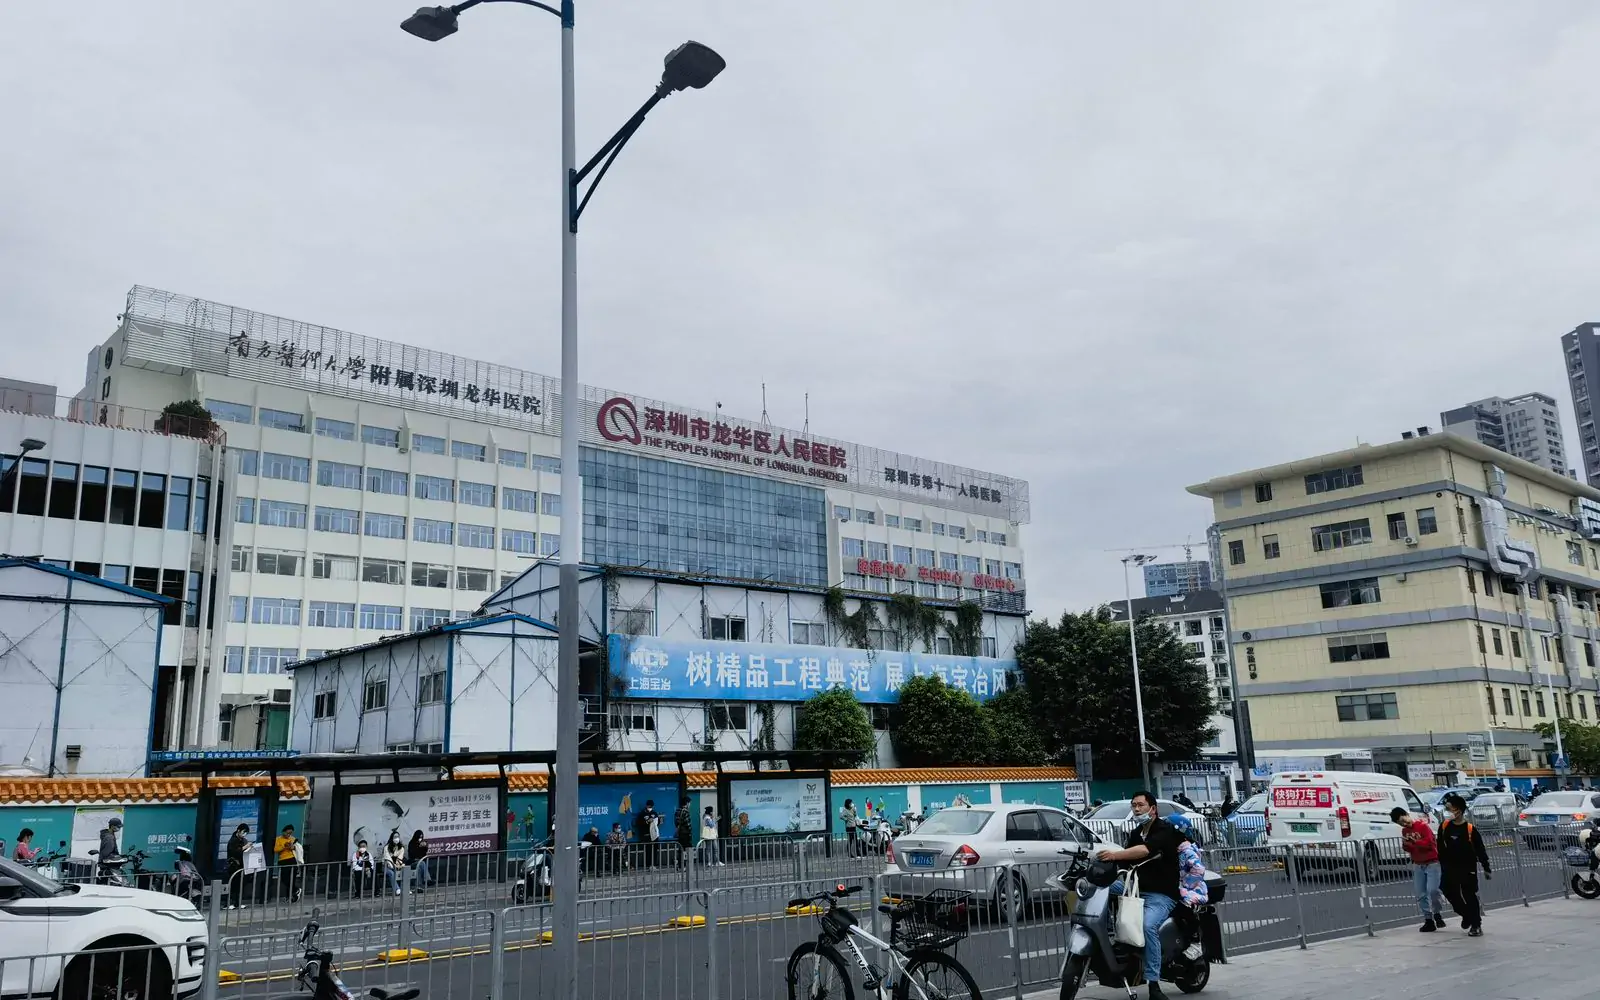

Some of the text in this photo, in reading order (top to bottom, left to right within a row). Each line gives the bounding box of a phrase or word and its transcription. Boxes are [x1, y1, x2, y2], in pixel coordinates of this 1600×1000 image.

[643, 435, 663, 448] THE
[665, 440, 709, 457] PEOPLE'S
[710, 449, 752, 465] HOSPITAL
[753, 457, 765, 466] OF
[644, 406, 847, 468] 深圳市龙华区人民医院
[885, 467, 1002, 504] 深圳市第十一人民医院
[685, 650, 871, 691] 树精品工程典范
[1275, 789, 1317, 800] 快狗打车
[428, 808, 492, 823] 坐月子 到宝生
[445, 839, 491, 851] 22922888
